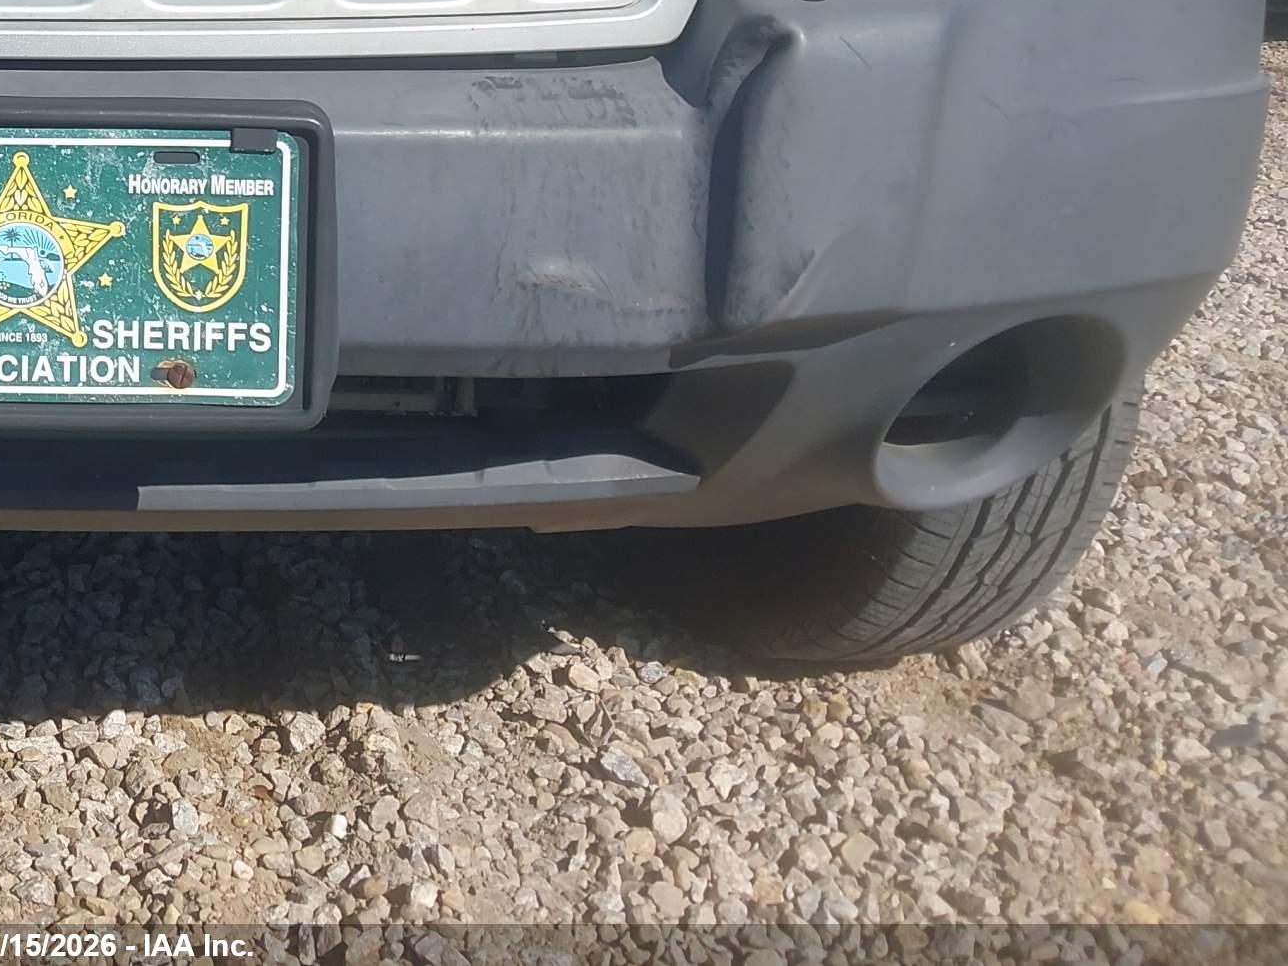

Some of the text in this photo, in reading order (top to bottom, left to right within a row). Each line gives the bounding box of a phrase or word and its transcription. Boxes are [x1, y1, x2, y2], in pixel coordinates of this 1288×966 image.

[128, 174, 274, 196] HONORARY MEMBER
[25, 333, 48, 342] 1893
[92, 319, 272, 352] SHERIFFS
